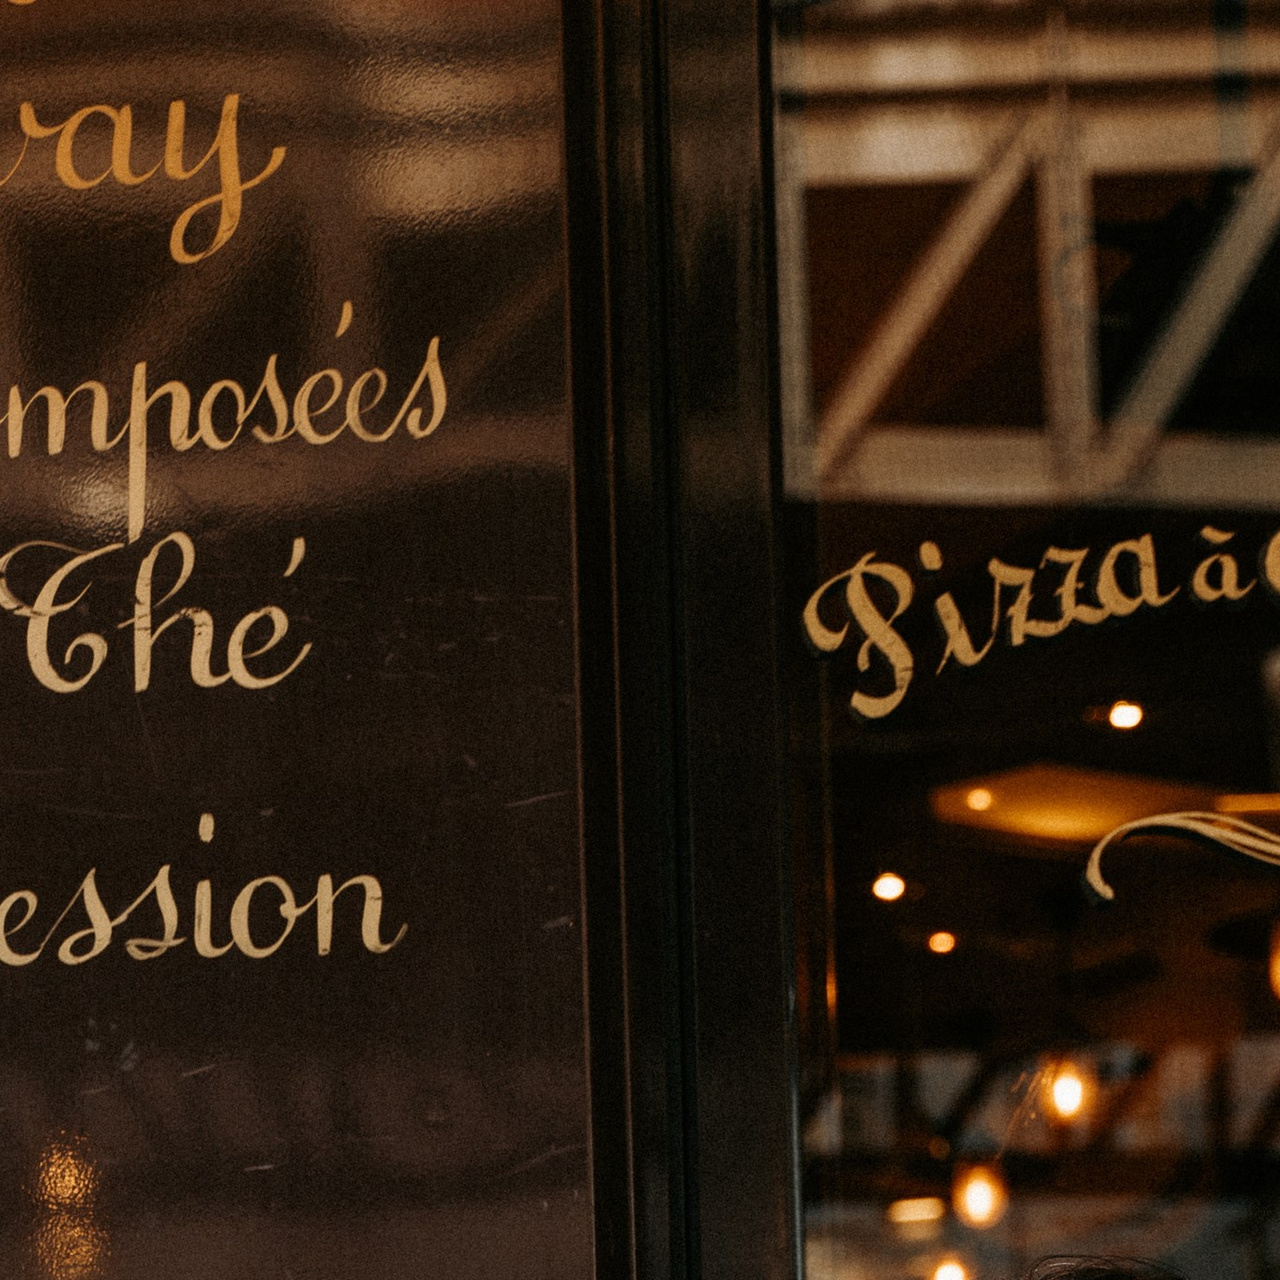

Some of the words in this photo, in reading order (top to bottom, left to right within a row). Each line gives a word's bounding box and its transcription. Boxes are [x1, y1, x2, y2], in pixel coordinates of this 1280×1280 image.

[0, 301, 447, 545] mposées
[0, 531, 312, 693] Thé
[802, 532, 1179, 719] Pizza
[1192, 526, 1258, 601] à
[0, 813, 409, 966] ession
